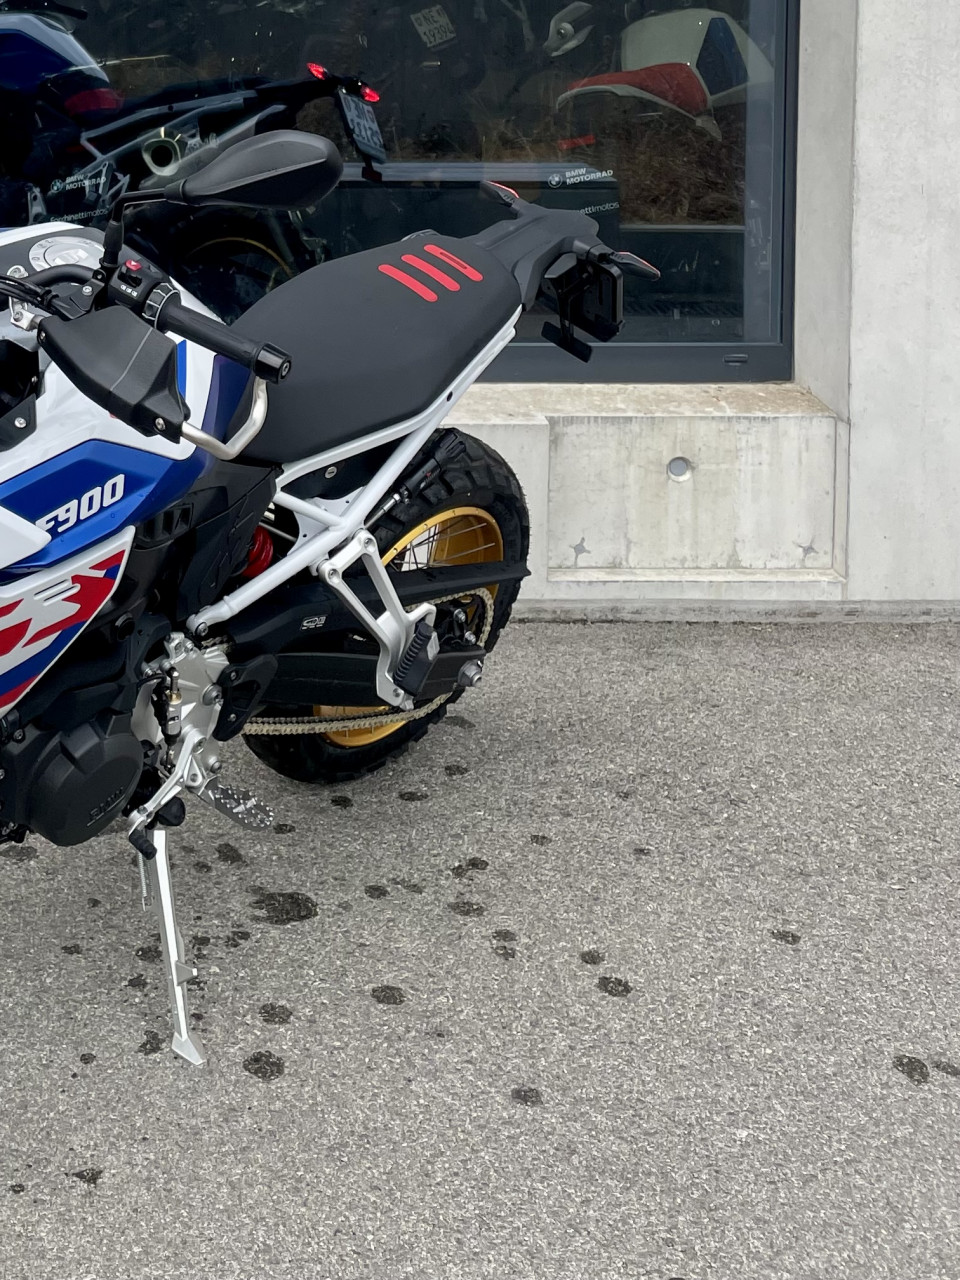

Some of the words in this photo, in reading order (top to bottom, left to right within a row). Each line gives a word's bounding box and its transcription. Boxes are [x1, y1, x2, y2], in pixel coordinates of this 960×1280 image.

[565, 167, 587, 178] BMW
[566, 169, 614, 185] MOTORRAD
[65, 176, 107, 190] MOTORRAD
[578, 201, 620, 215] ettimotos
[35, 473, 125, 533] F900
